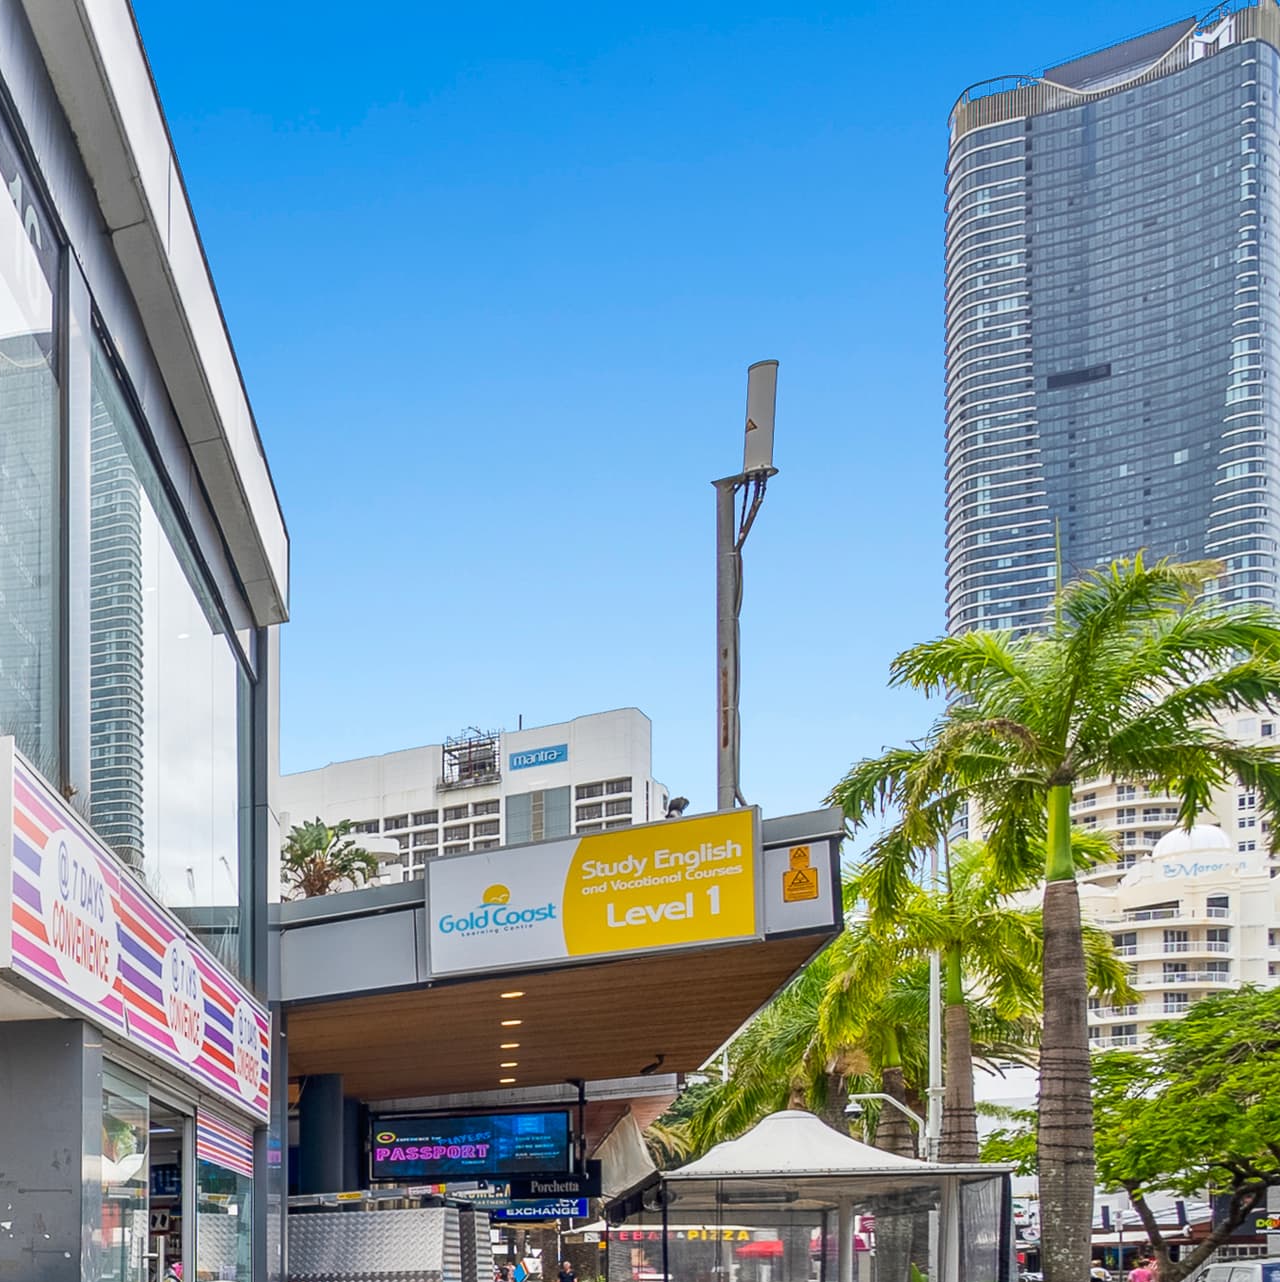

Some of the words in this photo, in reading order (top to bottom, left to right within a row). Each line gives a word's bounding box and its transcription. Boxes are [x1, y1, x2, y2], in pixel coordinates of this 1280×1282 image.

[513, 750, 562, 768] mantra
[582, 855, 648, 879] Study
[654, 840, 742, 870] English
[58, 840, 69, 900] @
[73, 860, 78, 900] 7
[80, 867, 104, 923] DAYS
[582, 882, 607, 896] and
[610, 872, 682, 890] Vocational
[686, 865, 742, 880] Courses
[439, 910, 489, 934] Gold
[492, 903, 556, 926] Coast
[607, 892, 694, 928] Level
[706, 886, 720, 915] 1
[53, 899, 108, 983] CONVENIENCE
[462, 928, 499, 936] Learning
[376, 1144, 490, 1162] PASSPORT
[531, 1180, 580, 1193] Porchetta
[506, 1207, 579, 1216] EXCHANGE
[688, 1230, 750, 1241] PIZZA
